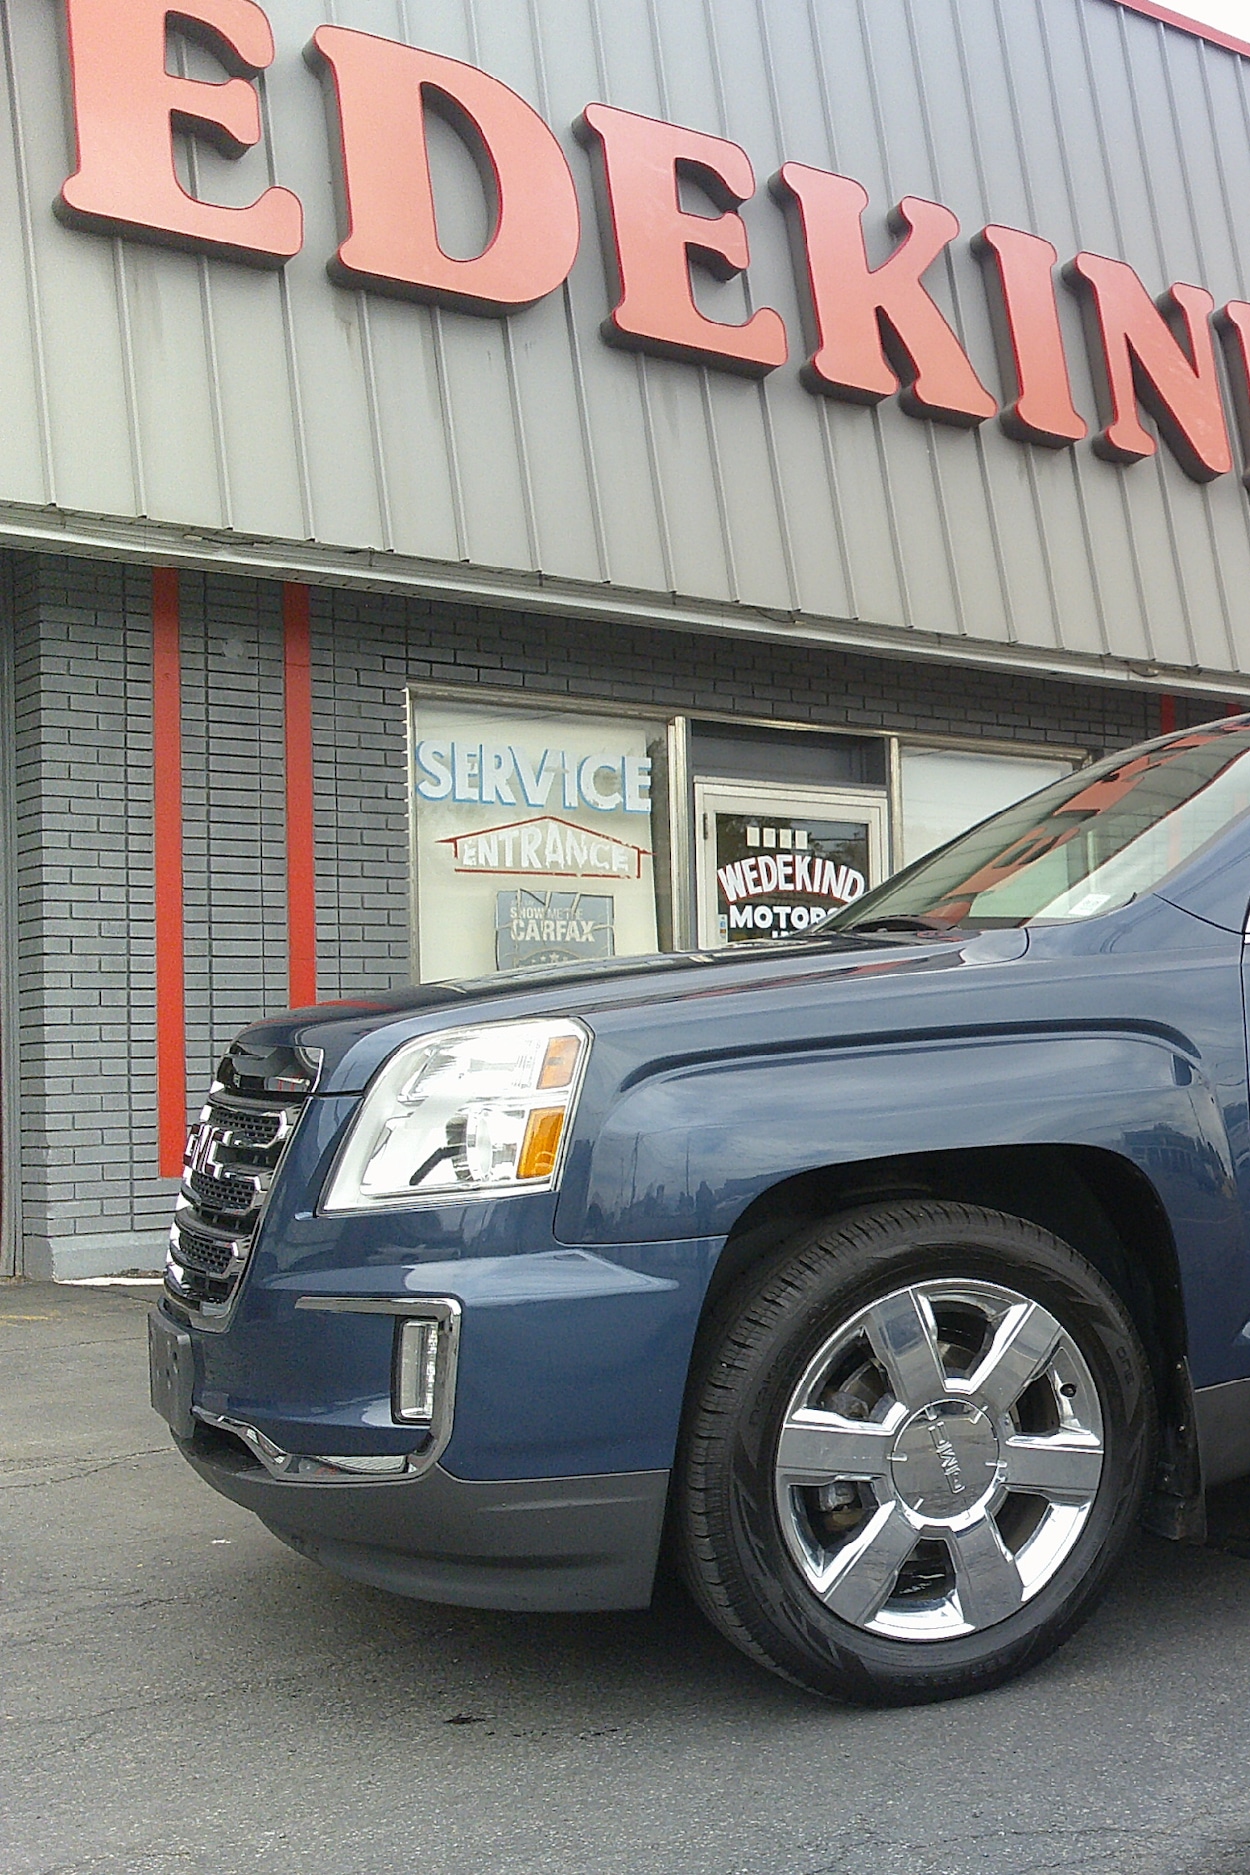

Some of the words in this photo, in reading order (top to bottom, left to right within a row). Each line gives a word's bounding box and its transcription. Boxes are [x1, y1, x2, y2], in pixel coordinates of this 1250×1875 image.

[415, 740, 652, 815] SERVICE
[462, 823, 629, 872] ENTRANCE
[717, 853, 866, 904] WEDEKIND
[510, 919, 596, 942] CARFAX
[927, 1421, 966, 1494] GMC
